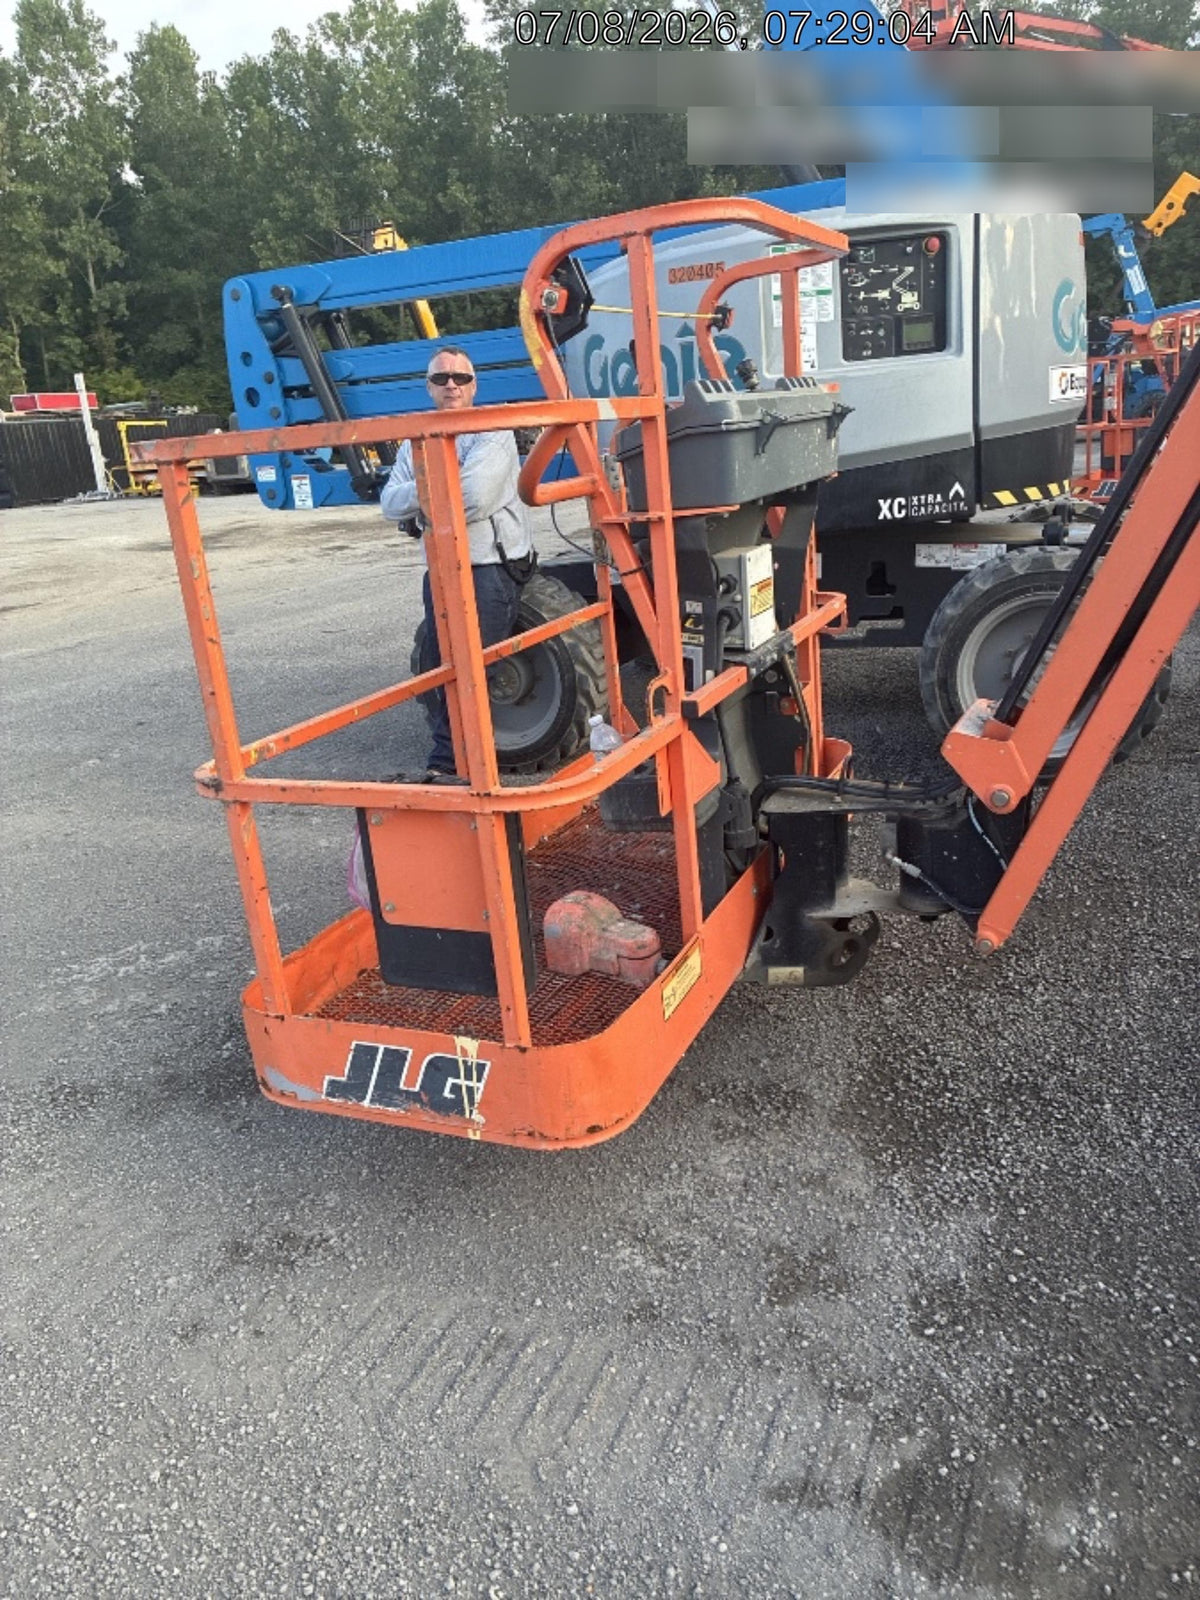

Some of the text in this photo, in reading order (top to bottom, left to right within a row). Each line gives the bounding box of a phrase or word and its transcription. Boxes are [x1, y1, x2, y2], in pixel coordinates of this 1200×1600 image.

[878, 497, 907, 520] XC
[911, 493, 943, 506] XTRA
[322, 1040, 492, 1119] JLG
